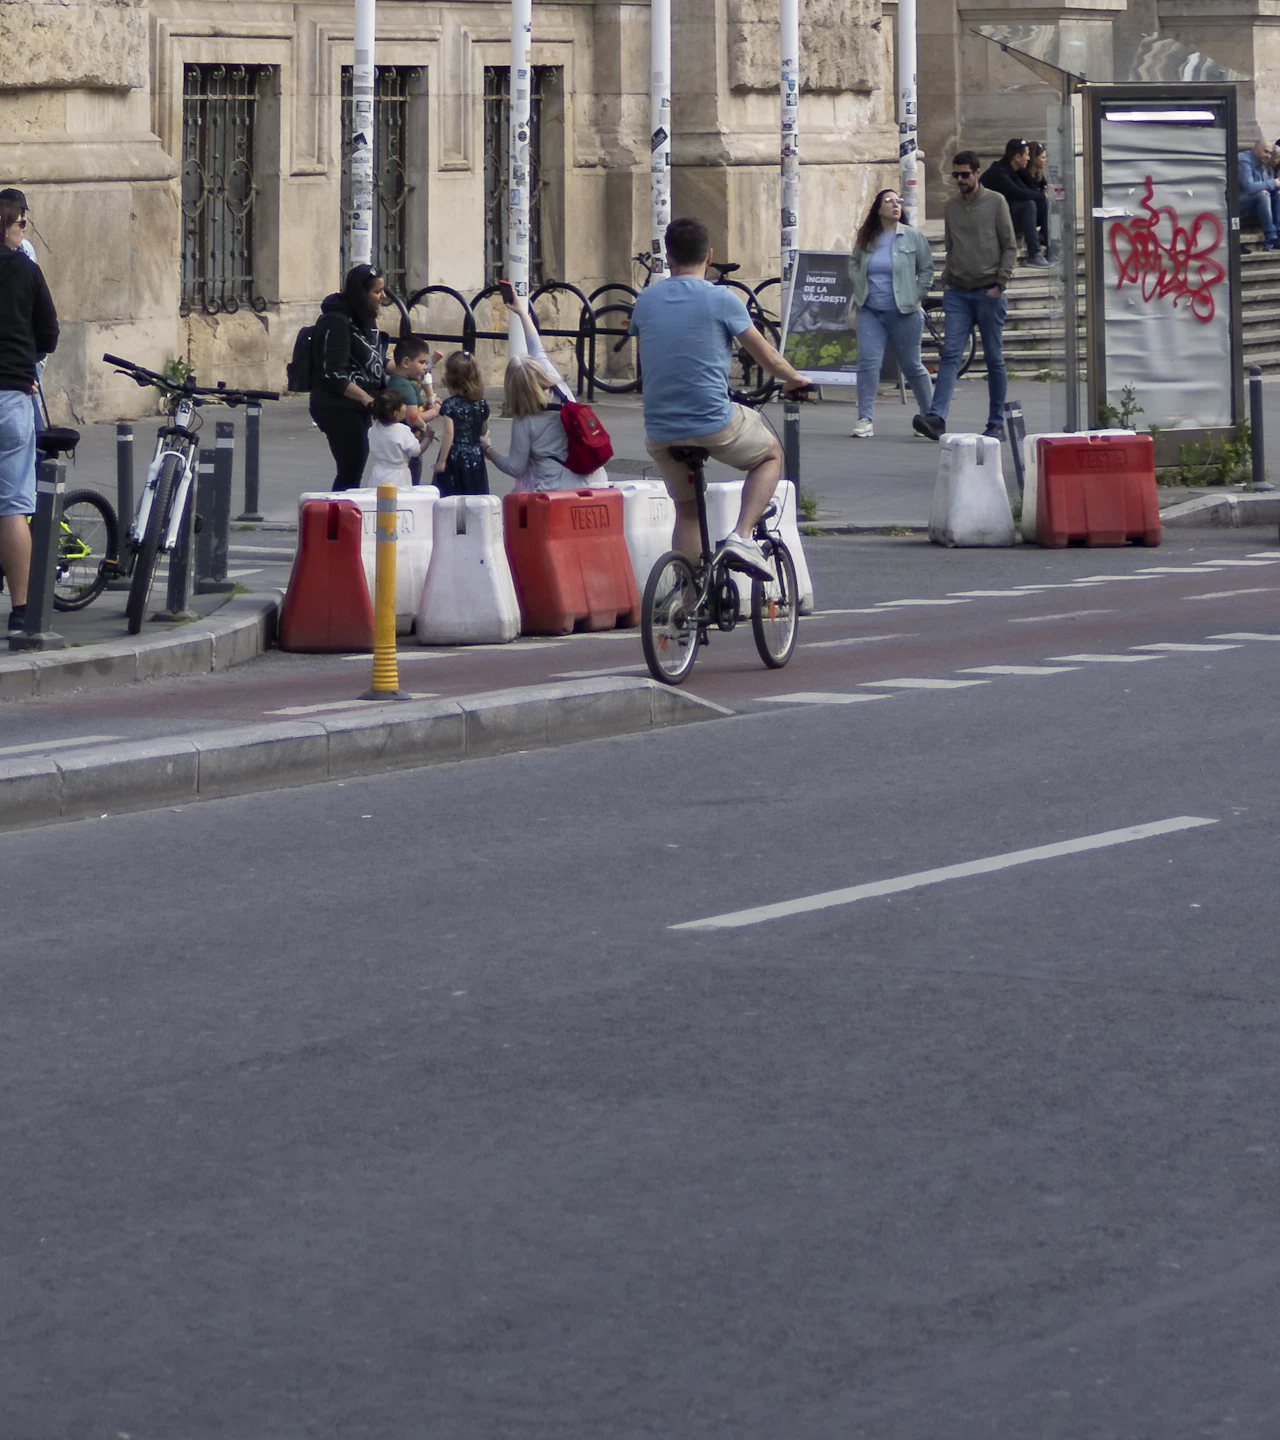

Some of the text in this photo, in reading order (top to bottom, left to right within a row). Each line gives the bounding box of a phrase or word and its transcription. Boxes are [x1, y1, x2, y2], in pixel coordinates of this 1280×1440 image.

[806, 274, 836, 284] ÎNGERII
[803, 285, 815, 293] DE
[570, 507, 608, 530] VESTA
